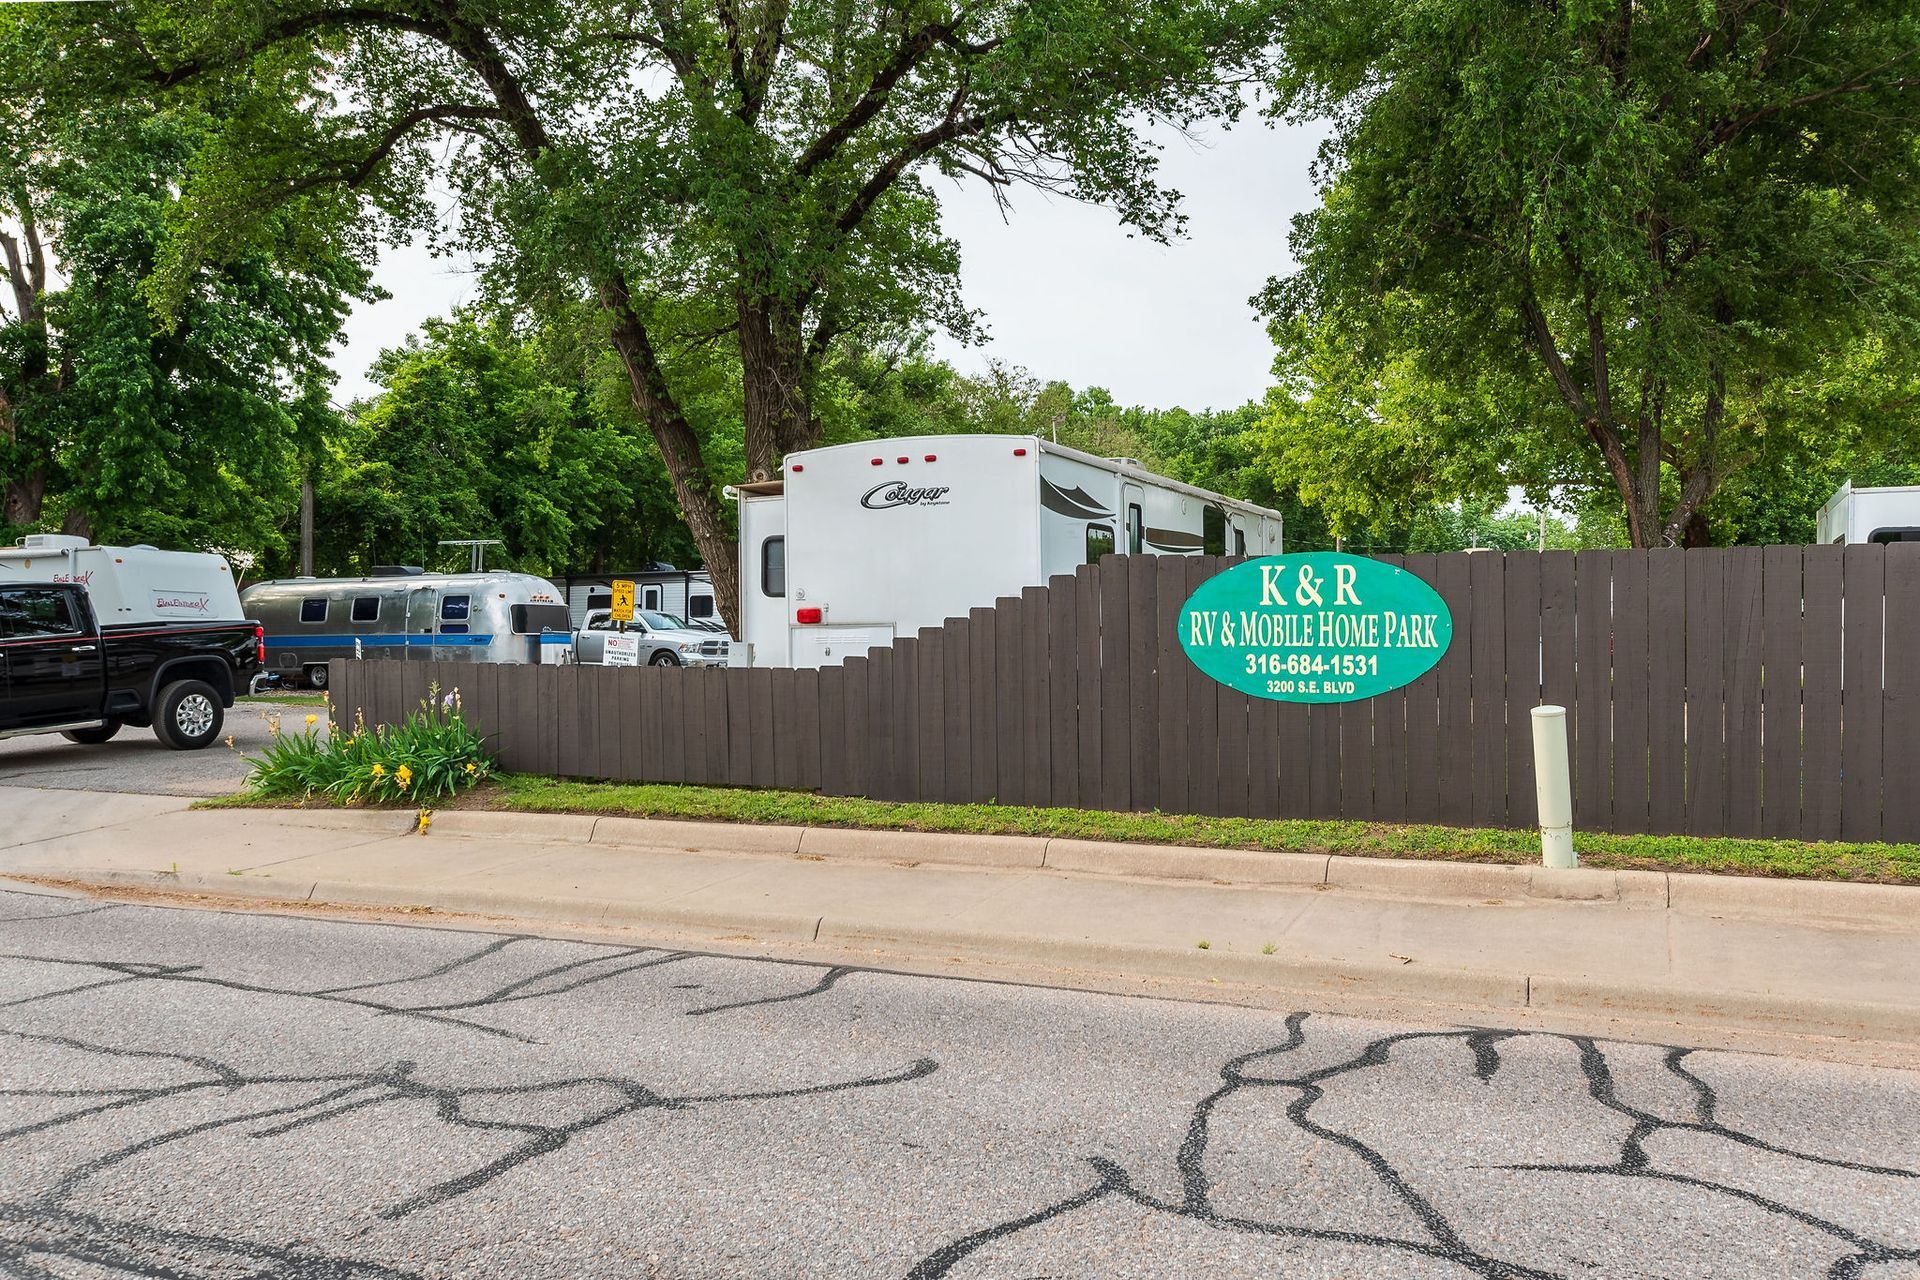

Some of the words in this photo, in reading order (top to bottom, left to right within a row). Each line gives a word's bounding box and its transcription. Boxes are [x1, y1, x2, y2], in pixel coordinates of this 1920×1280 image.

[861, 481, 950, 509] Cougar
[1259, 565, 1288, 606] K
[1295, 564, 1324, 608] &
[1333, 564, 1362, 606] R
[1189, 611, 1218, 646] RV
[1221, 611, 1236, 648] &
[1239, 611, 1314, 647] MOBILE
[1317, 611, 1379, 648] HOME
[1383, 611, 1439, 648] PARK
[608, 639, 618, 647] NO
[1245, 653, 1378, 676] 316-684-1531
[1266, 680, 1295, 693] 3200
[1298, 681, 1319, 694] S.E.
[1323, 681, 1355, 694] BLVD
